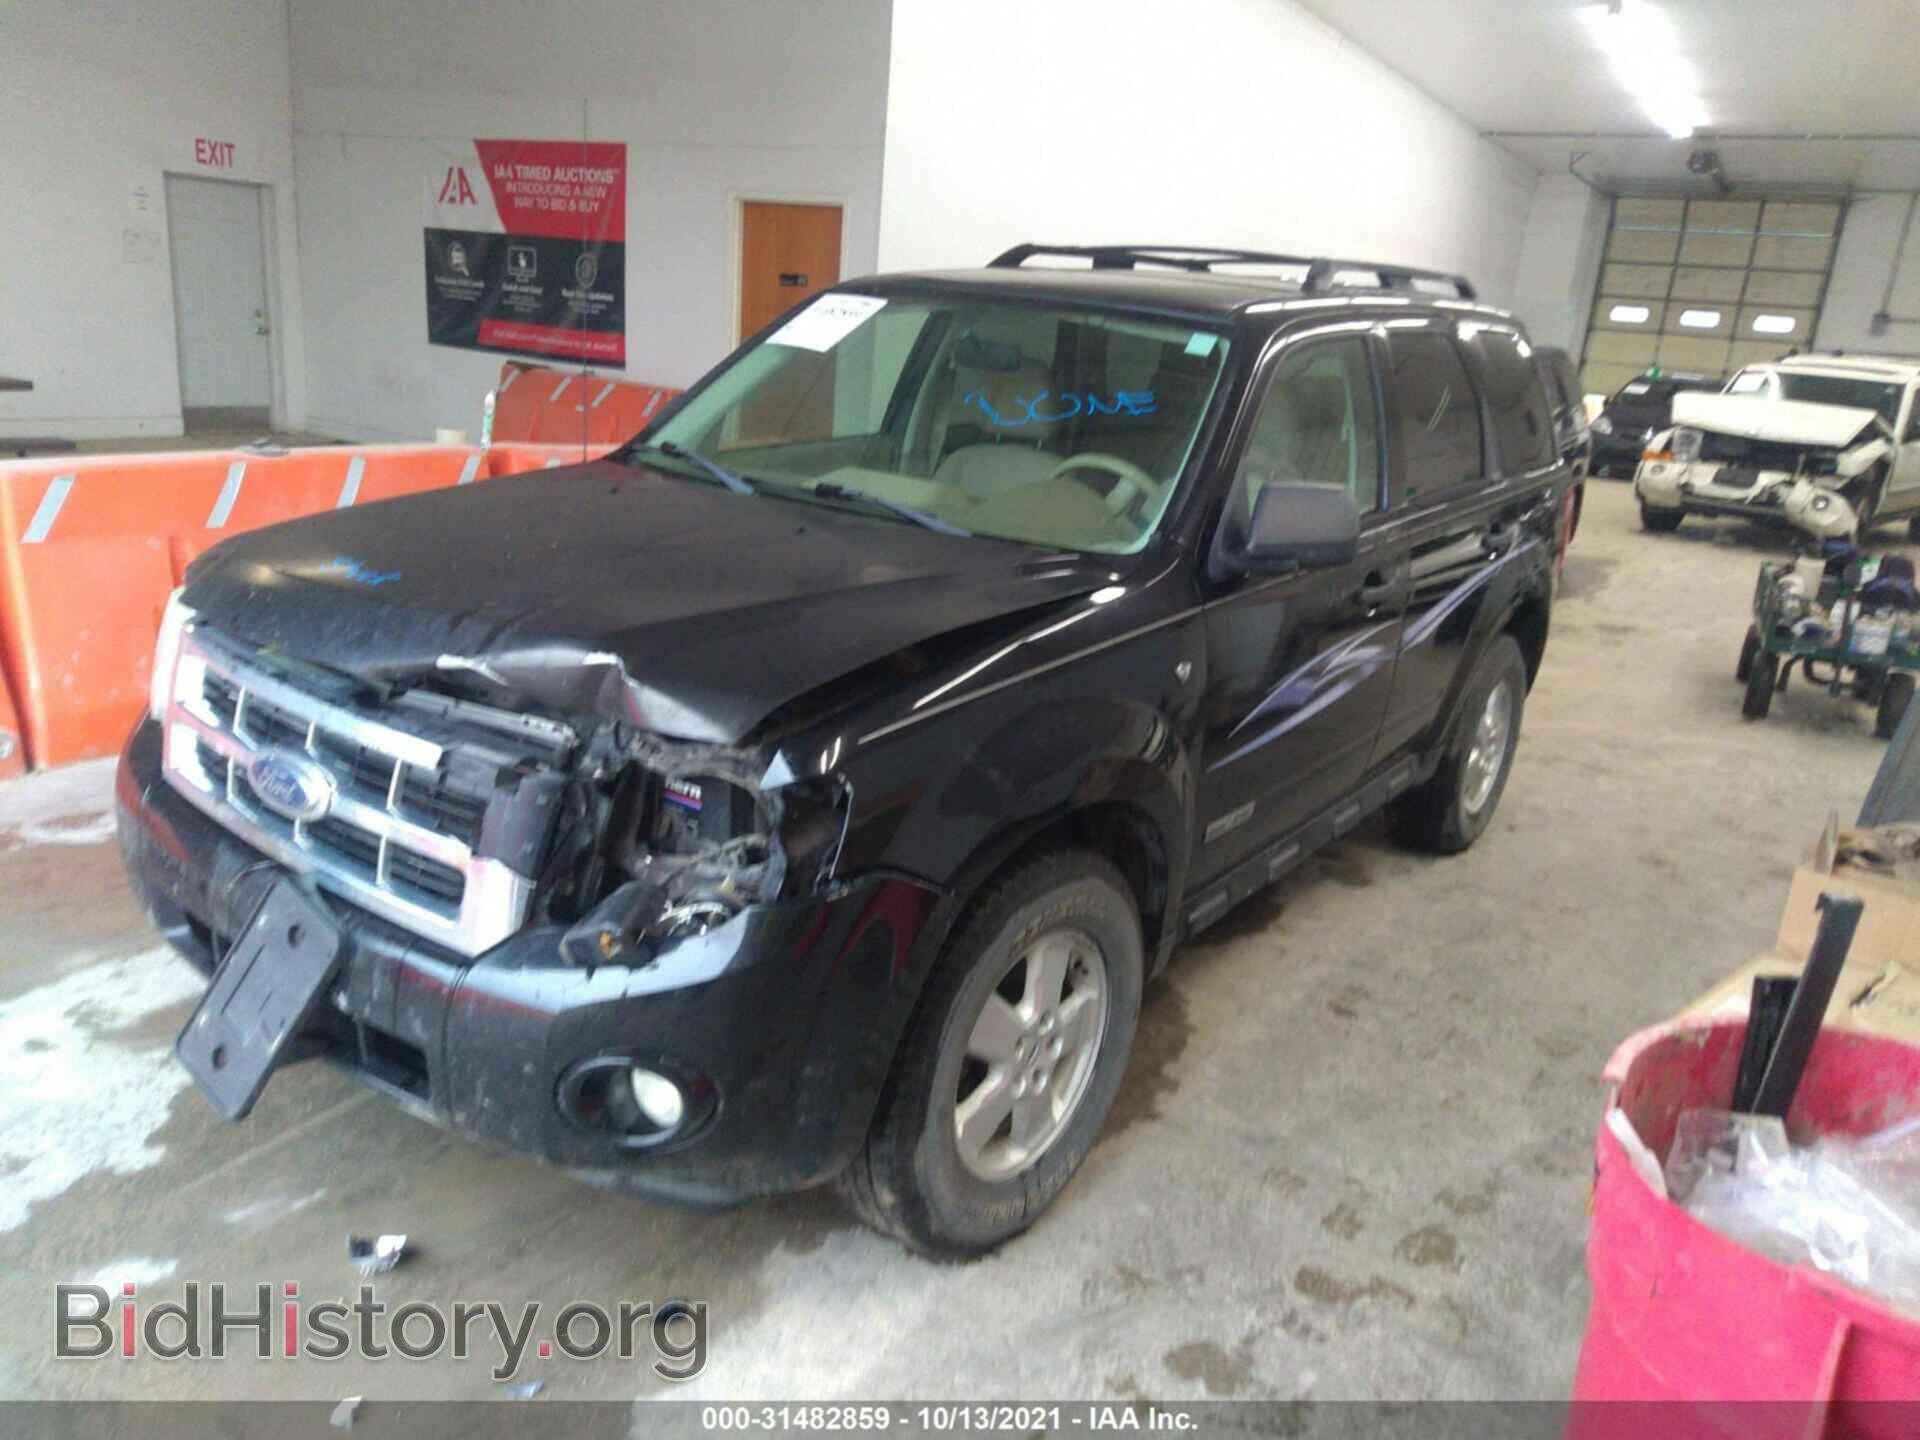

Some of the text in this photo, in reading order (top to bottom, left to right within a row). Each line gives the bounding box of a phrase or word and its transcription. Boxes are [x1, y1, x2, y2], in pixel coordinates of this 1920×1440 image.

[195, 138, 236, 168] EXIT
[515, 165, 551, 180] TIMED
[506, 181, 608, 199] INTRODUCING A NEW
[514, 196, 601, 213] WAY TO BID & BUY
[257, 766, 298, 802] Ford
